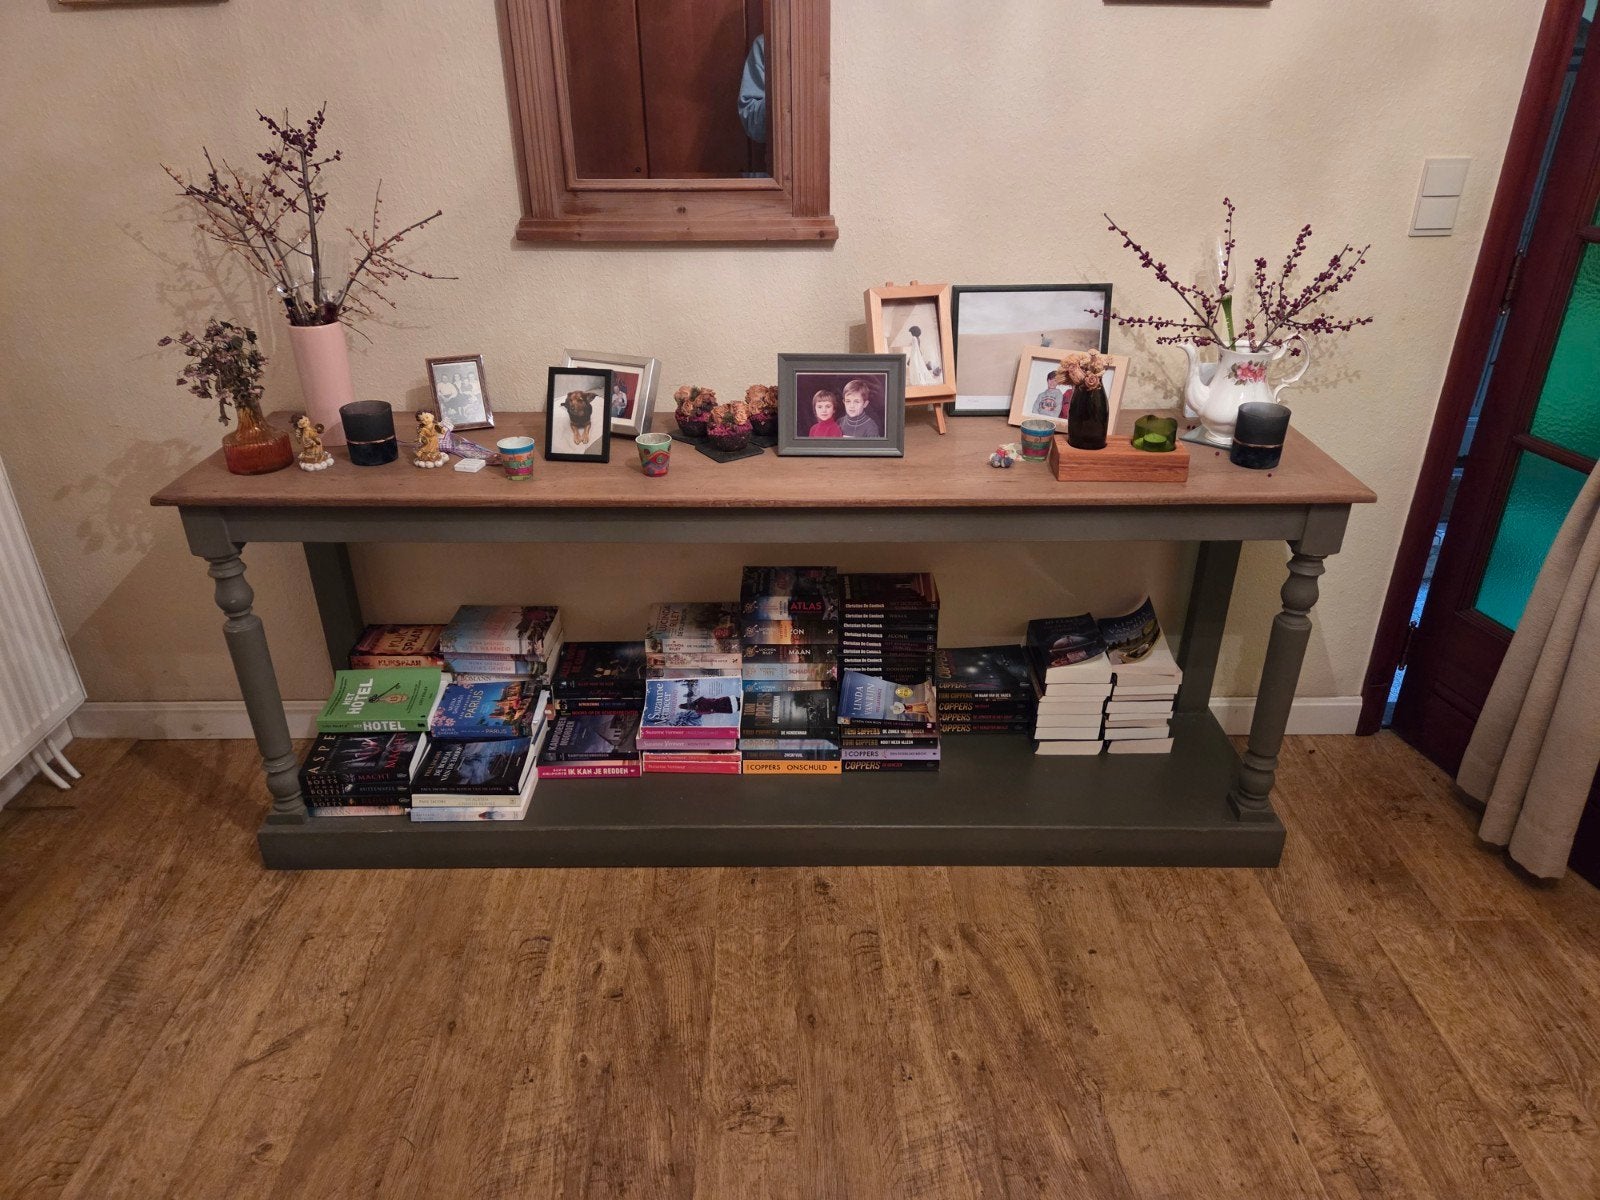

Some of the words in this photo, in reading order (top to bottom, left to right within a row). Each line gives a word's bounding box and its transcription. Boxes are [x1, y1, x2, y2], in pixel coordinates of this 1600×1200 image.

[790, 602, 823, 611] ATLAS
[342, 693, 356, 706] HET
[346, 678, 374, 715] HOTEL
[465, 690, 484, 718] PARIJS
[647, 682, 664, 720] Suzanne
[853, 685, 864, 711] LINDA
[654, 691, 672, 726] Vermeer
[938, 703, 973, 711] COPPERS
[363, 721, 405, 731] HOTEL
[567, 768, 576, 776] IK
